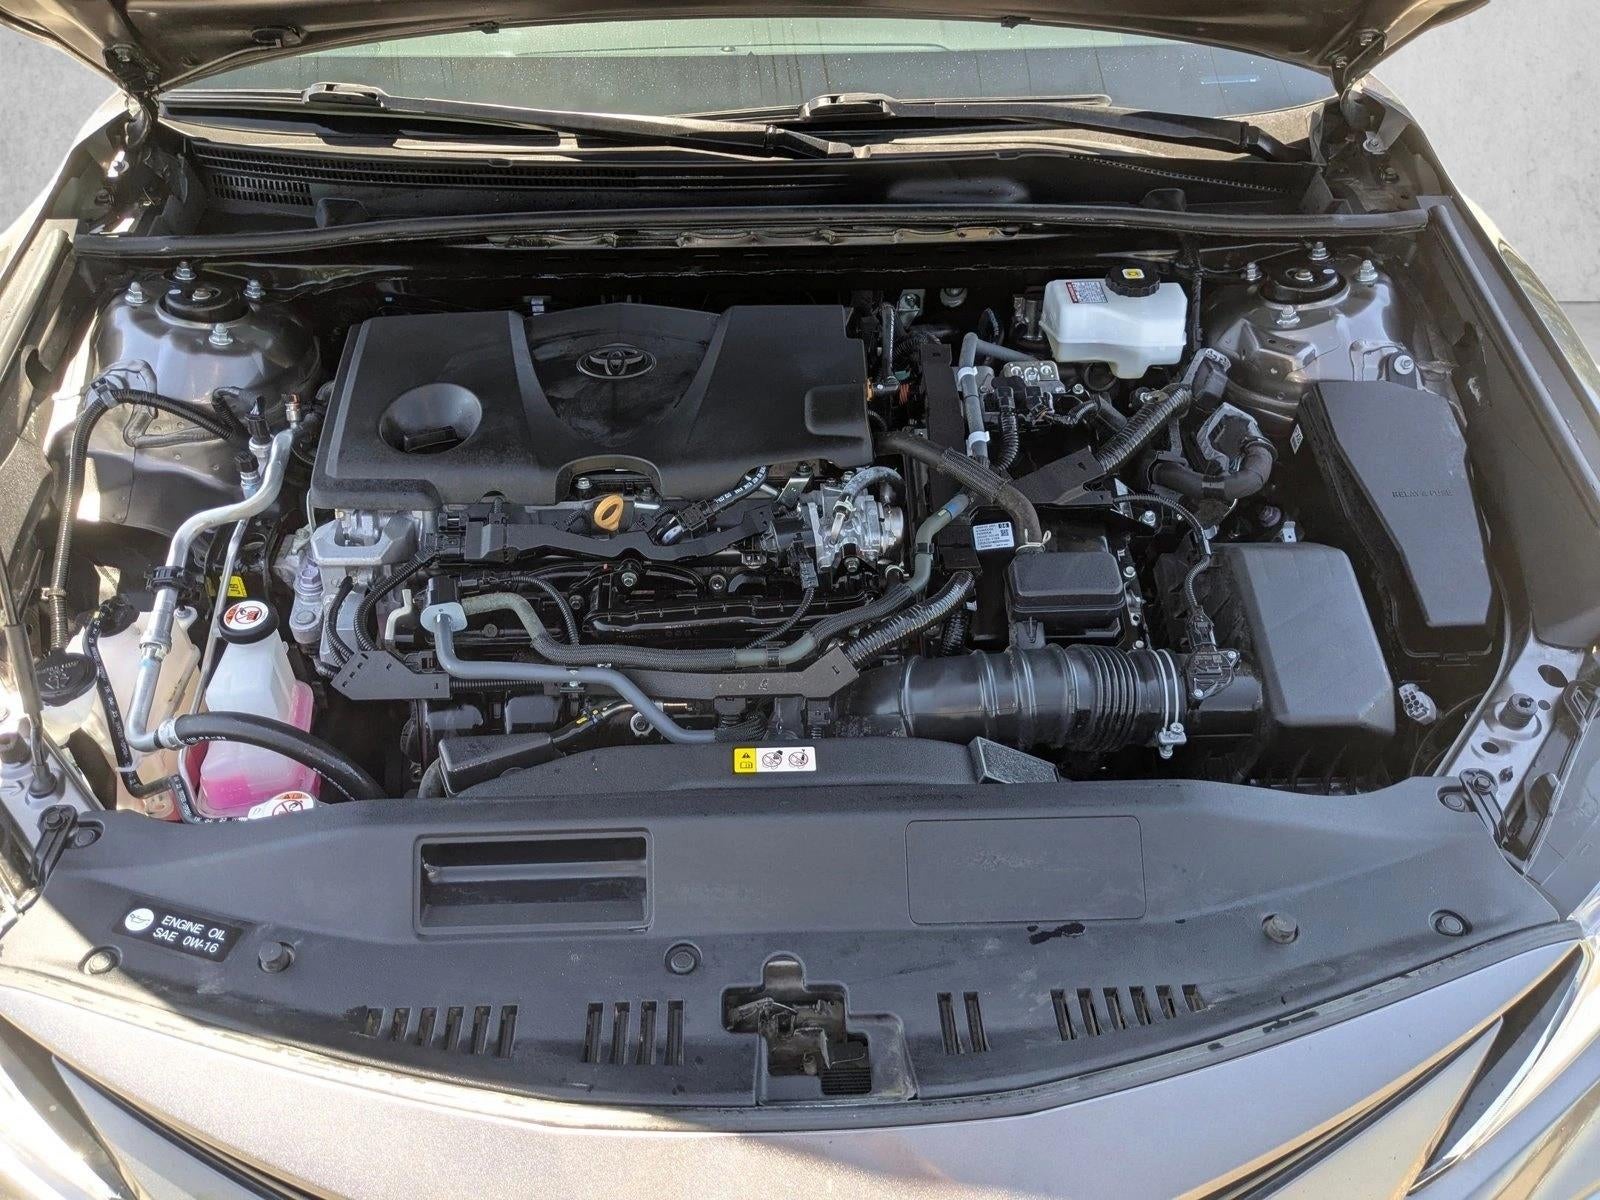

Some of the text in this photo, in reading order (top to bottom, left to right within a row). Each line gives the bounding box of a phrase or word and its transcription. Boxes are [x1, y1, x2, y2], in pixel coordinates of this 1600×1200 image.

[153, 928, 219, 953] SAE 0W-16
[161, 915, 226, 941] ENGINE OIL
